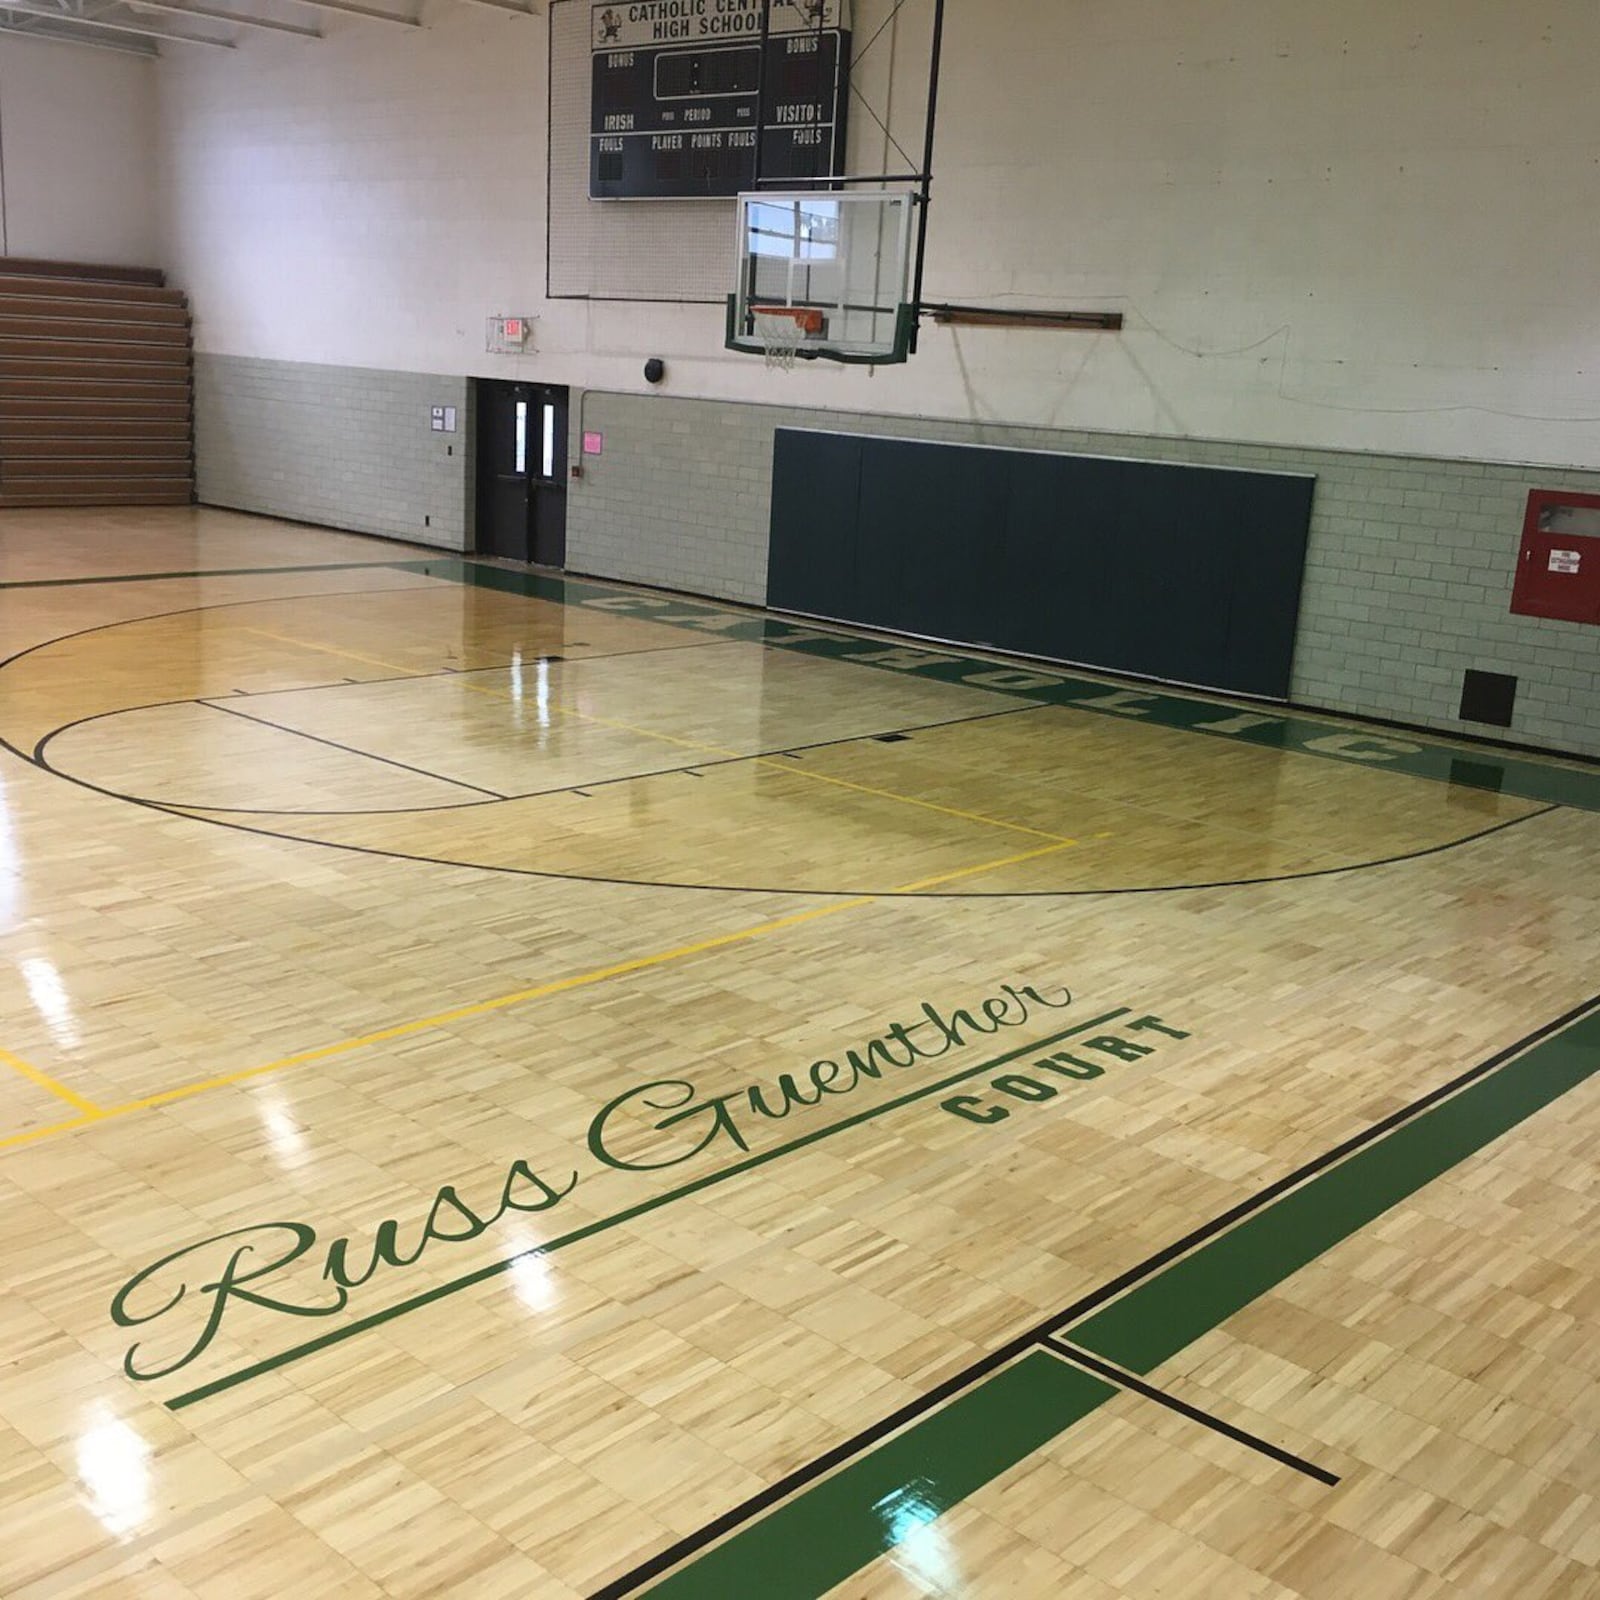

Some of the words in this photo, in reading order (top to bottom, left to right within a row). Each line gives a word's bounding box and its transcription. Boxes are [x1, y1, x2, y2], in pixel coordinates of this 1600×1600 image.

[629, 0, 706, 23] CATHOLIC
[653, 18, 689, 39] HIGH
[787, 37, 818, 54] BONUS
[608, 53, 634, 67] BONUS
[604, 114, 634, 131] IRISH
[683, 108, 711, 121] PERIOD
[599, 136, 623, 152] FOULS
[652, 133, 682, 150] PLAYER
[691, 132, 722, 148] POINTS
[728, 130, 756, 147] FOULS
[793, 129, 822, 145] FOULS
[579, 597, 1423, 762] CATHOLIC
[940, 1015, 1192, 1124] COURT
[110, 1159, 578, 1380] Russ
[587, 983, 1071, 1170] Guenther
